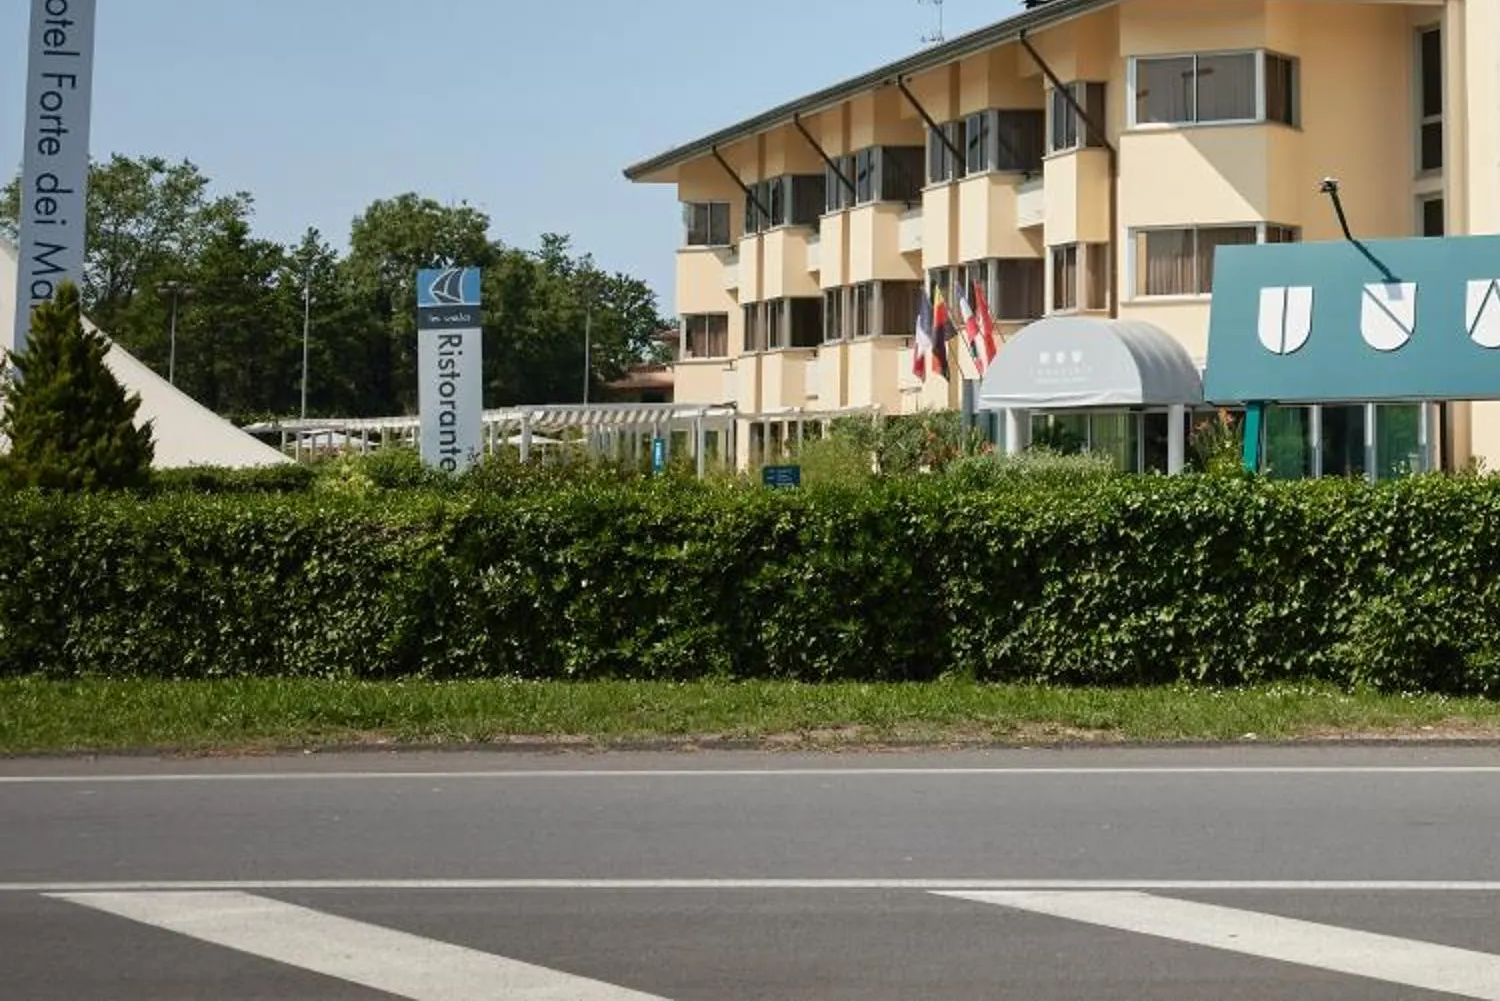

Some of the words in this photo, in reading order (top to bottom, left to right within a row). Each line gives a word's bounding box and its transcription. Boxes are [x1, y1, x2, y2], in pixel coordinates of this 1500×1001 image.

[37, 72, 77, 156] Forte
[33, 172, 74, 225] dei
[437, 334, 462, 473] Ristorante
